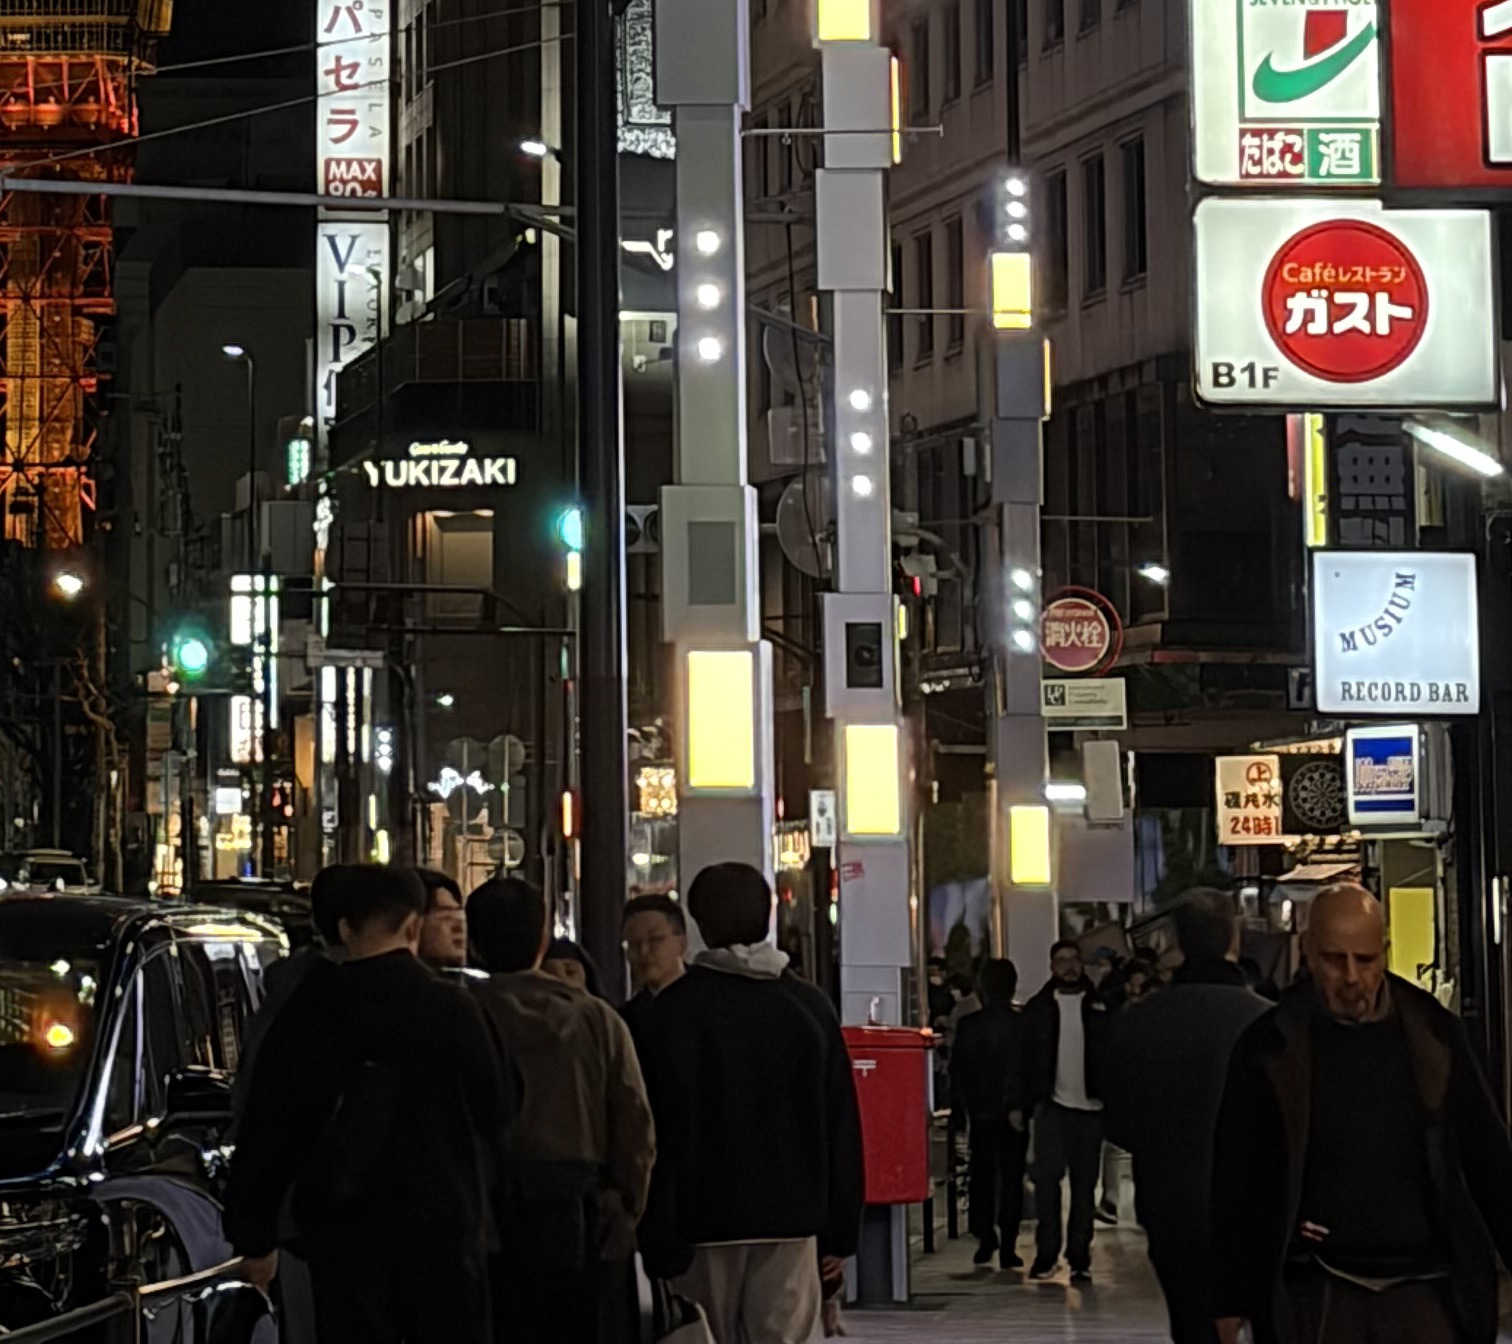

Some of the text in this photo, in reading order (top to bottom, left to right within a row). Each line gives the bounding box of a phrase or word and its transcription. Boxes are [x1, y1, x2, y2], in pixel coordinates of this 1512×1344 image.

[323, 0, 364, 144] パセラ
[368, 8, 383, 138] PASELA
[328, 160, 377, 181] MAX
[1242, 130, 1304, 177] たばこ
[1319, 132, 1362, 176] 酒
[1285, 290, 1412, 336] ガスト
[1211, 362, 1280, 389] B1F
[363, 457, 517, 488] YUKIZAKI
[1044, 620, 1103, 648] 消火栓
[1340, 571, 1417, 654] MUSIUM
[1340, 680, 1469, 703] RECORD BAR
